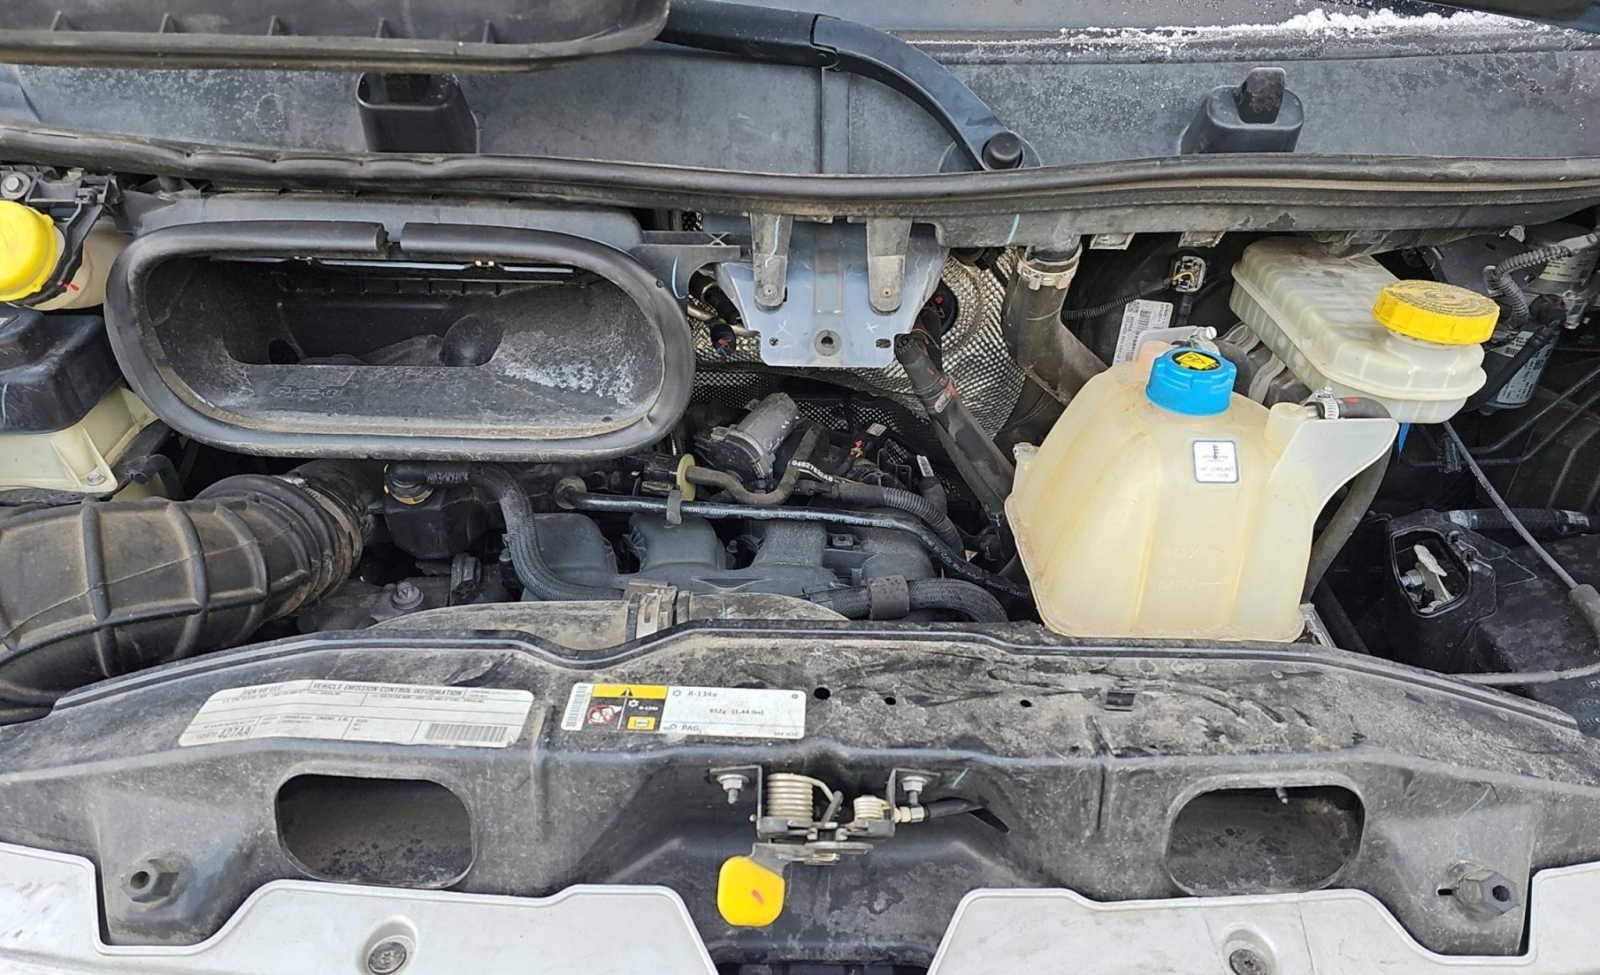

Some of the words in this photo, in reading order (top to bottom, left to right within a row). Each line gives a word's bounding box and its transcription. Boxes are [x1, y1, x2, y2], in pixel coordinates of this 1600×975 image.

[1158, 579, 1196, 592] MIN
[343, 684, 378, 692] EMISSION
[380, 686, 412, 695] CONTROL
[413, 688, 463, 697] INFORMATION
[688, 690, 718, 698] R-134a
